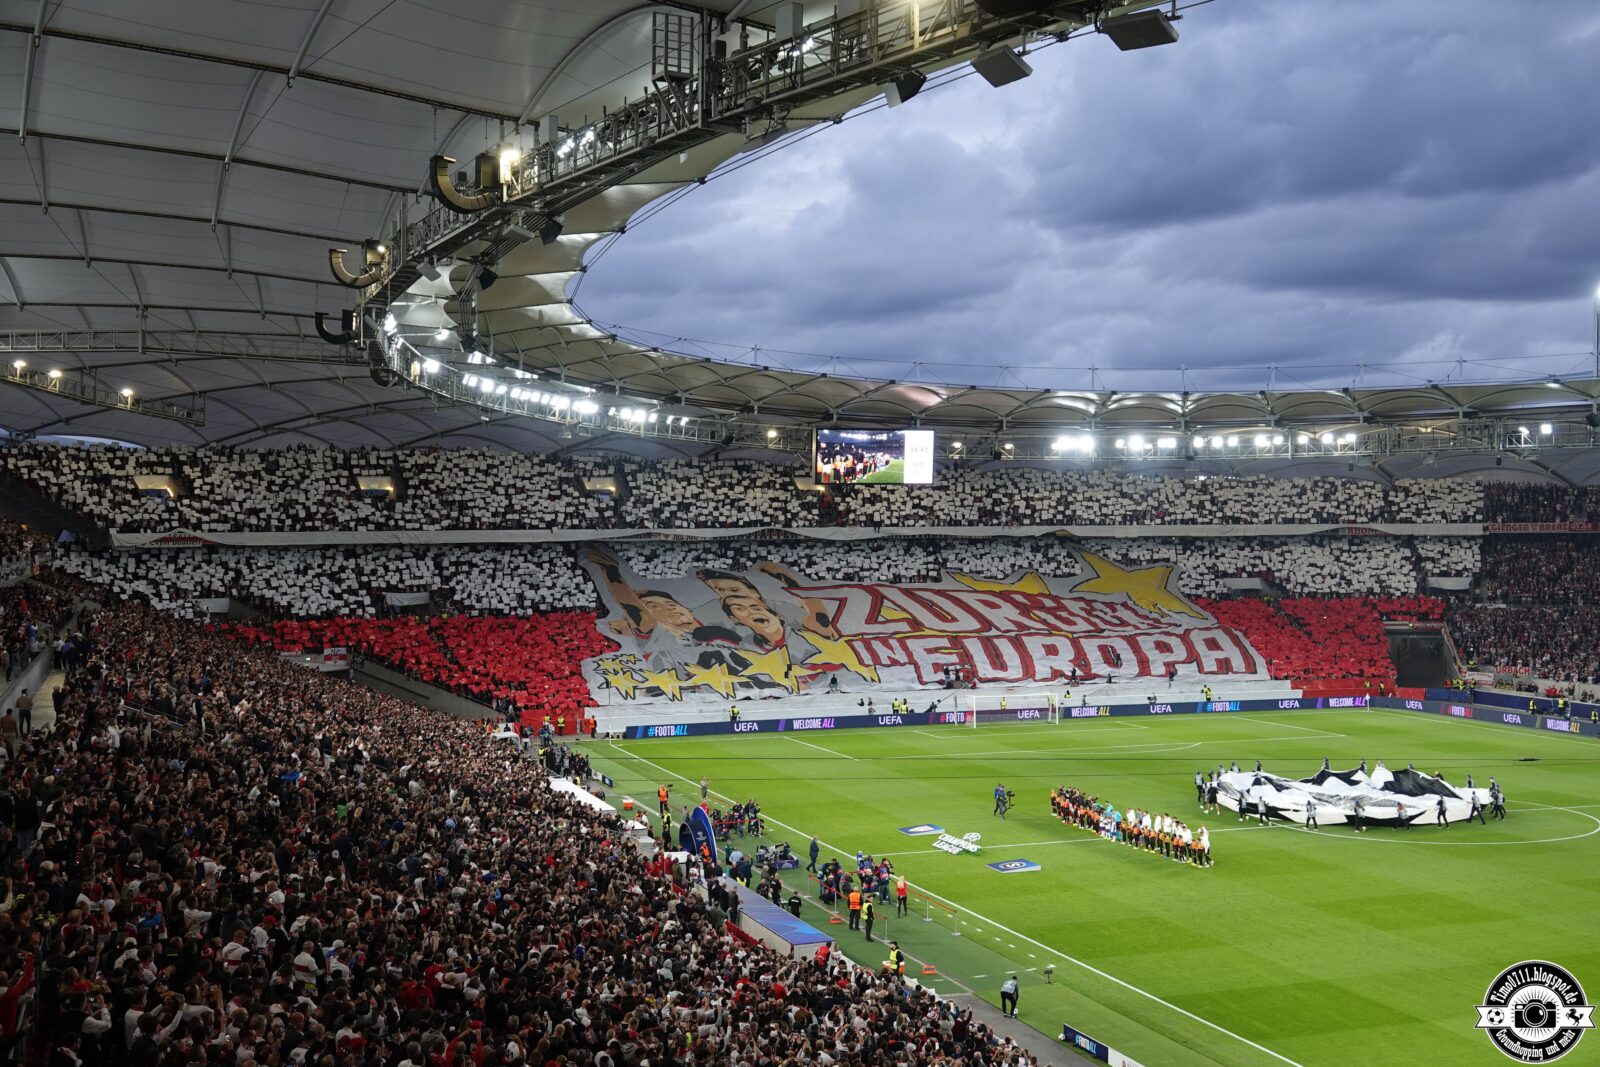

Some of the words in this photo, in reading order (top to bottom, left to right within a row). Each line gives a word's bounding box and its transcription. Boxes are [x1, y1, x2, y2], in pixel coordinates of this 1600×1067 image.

[847, 637, 906, 667] IN
[901, 626, 1257, 685] EUROPA
[1206, 702, 1240, 712] #FOOTBALL
[1278, 700, 1300, 709] UEFA
[1329, 697, 1354, 707] WELCOME
[1354, 696, 1366, 707] ALL
[1405, 701, 1423, 710] UEFA
[1017, 709, 1040, 719] UEFA
[1071, 707, 1098, 718] WELCOME
[1098, 706, 1110, 717] ALL
[1150, 704, 1172, 714] UEFA
[1448, 705, 1473, 717] #FOOTBALL
[793, 719, 822, 730] WELCOME
[822, 717, 835, 729] ALL
[878, 715, 903, 725] UEFA
[1503, 713, 1522, 724] UEFA
[648, 725, 688, 737] #FOOTBALL
[734, 722, 759, 732] UEFA
[1546, 719, 1570, 731] WELCOME
[1570, 722, 1581, 733] ALL
